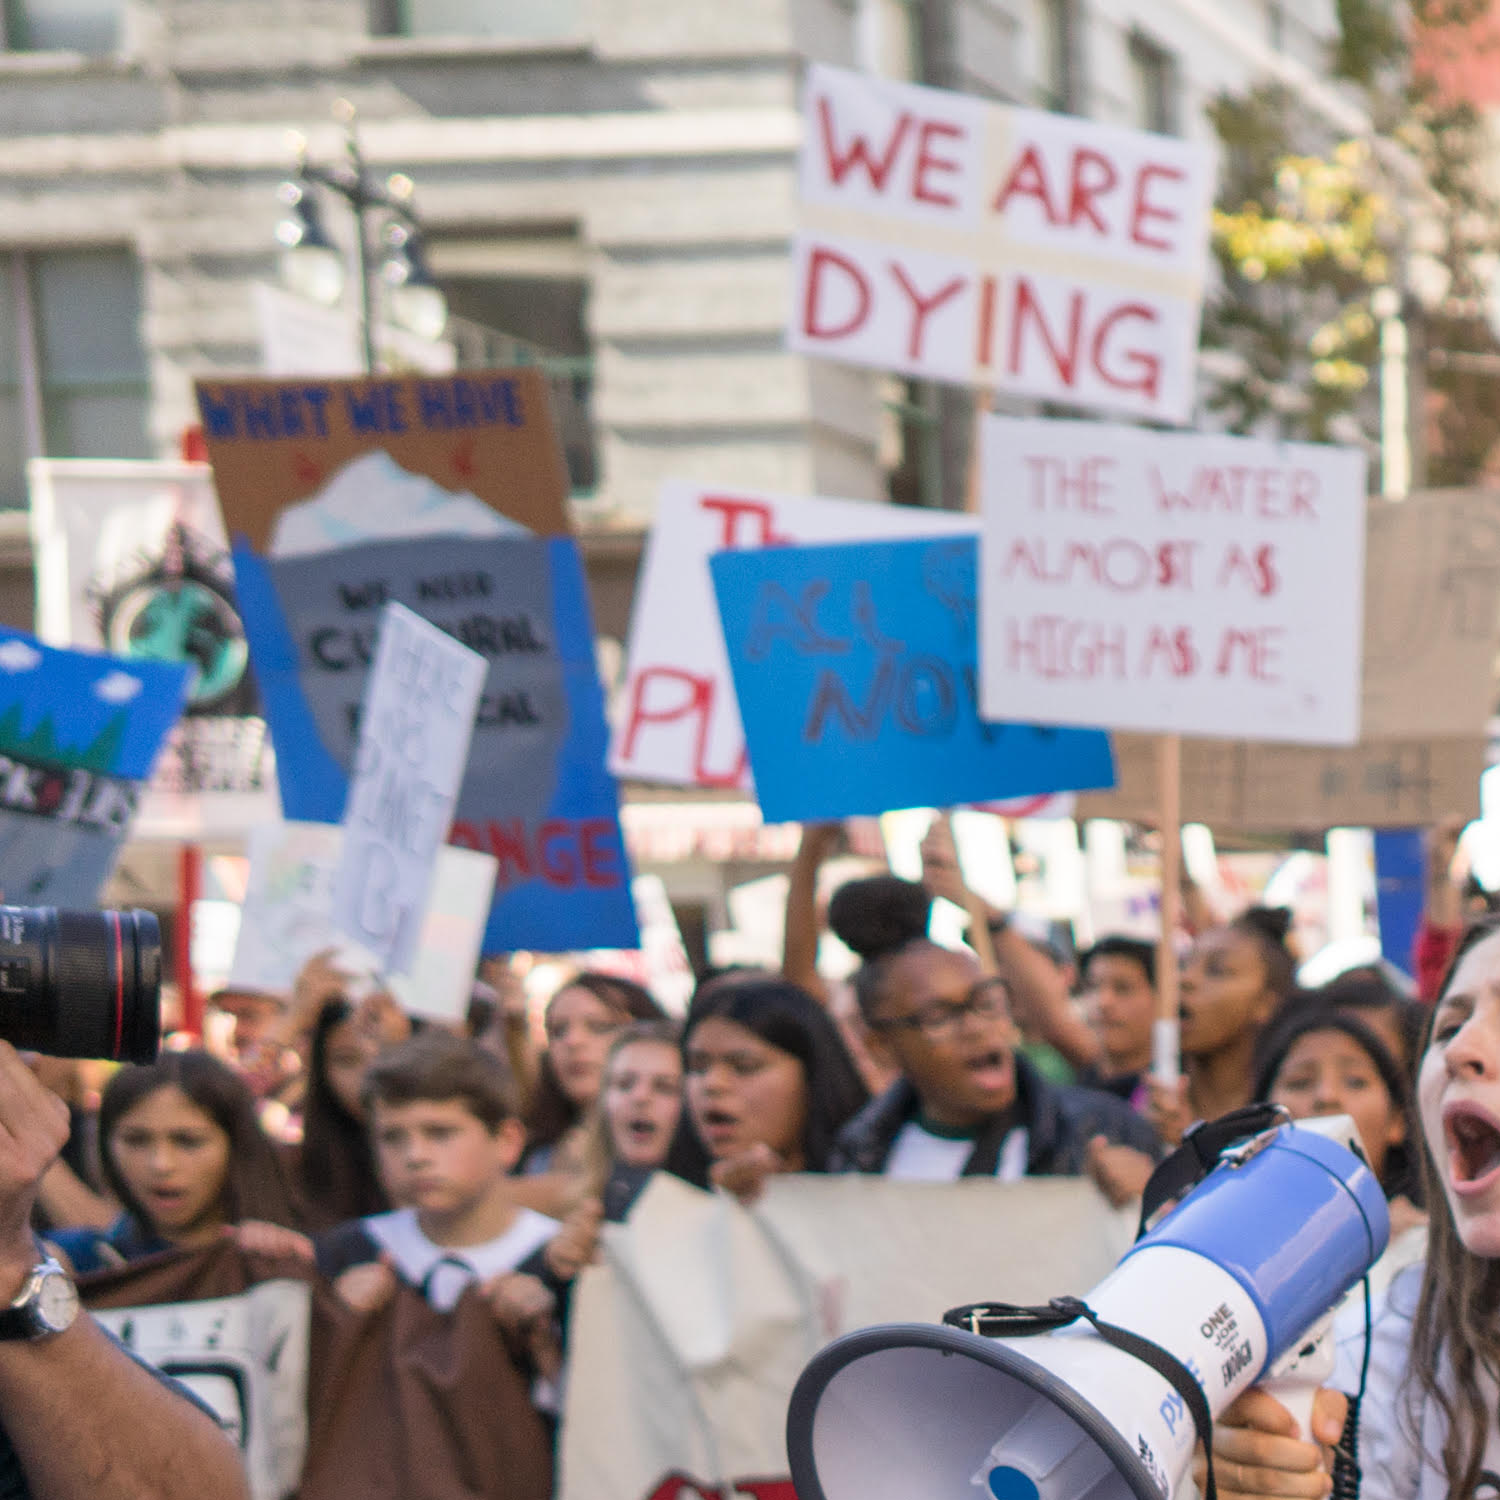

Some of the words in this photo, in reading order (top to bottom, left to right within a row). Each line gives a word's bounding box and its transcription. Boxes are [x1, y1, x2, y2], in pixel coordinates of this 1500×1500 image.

[816, 95, 965, 208] WE
[989, 142, 1188, 253] ARE
[803, 245, 1163, 402] DYING
[200, 386, 330, 440] WHAT
[418, 378, 523, 428] HAVE
[1022, 454, 1118, 515] THE
[1147, 461, 1322, 521] WATER
[1003, 536, 1200, 594] ALMOST
[1003, 613, 1127, 681] HIGH
[1215, 624, 1287, 682] ME
[1199, 1302, 1235, 1340] ONE
